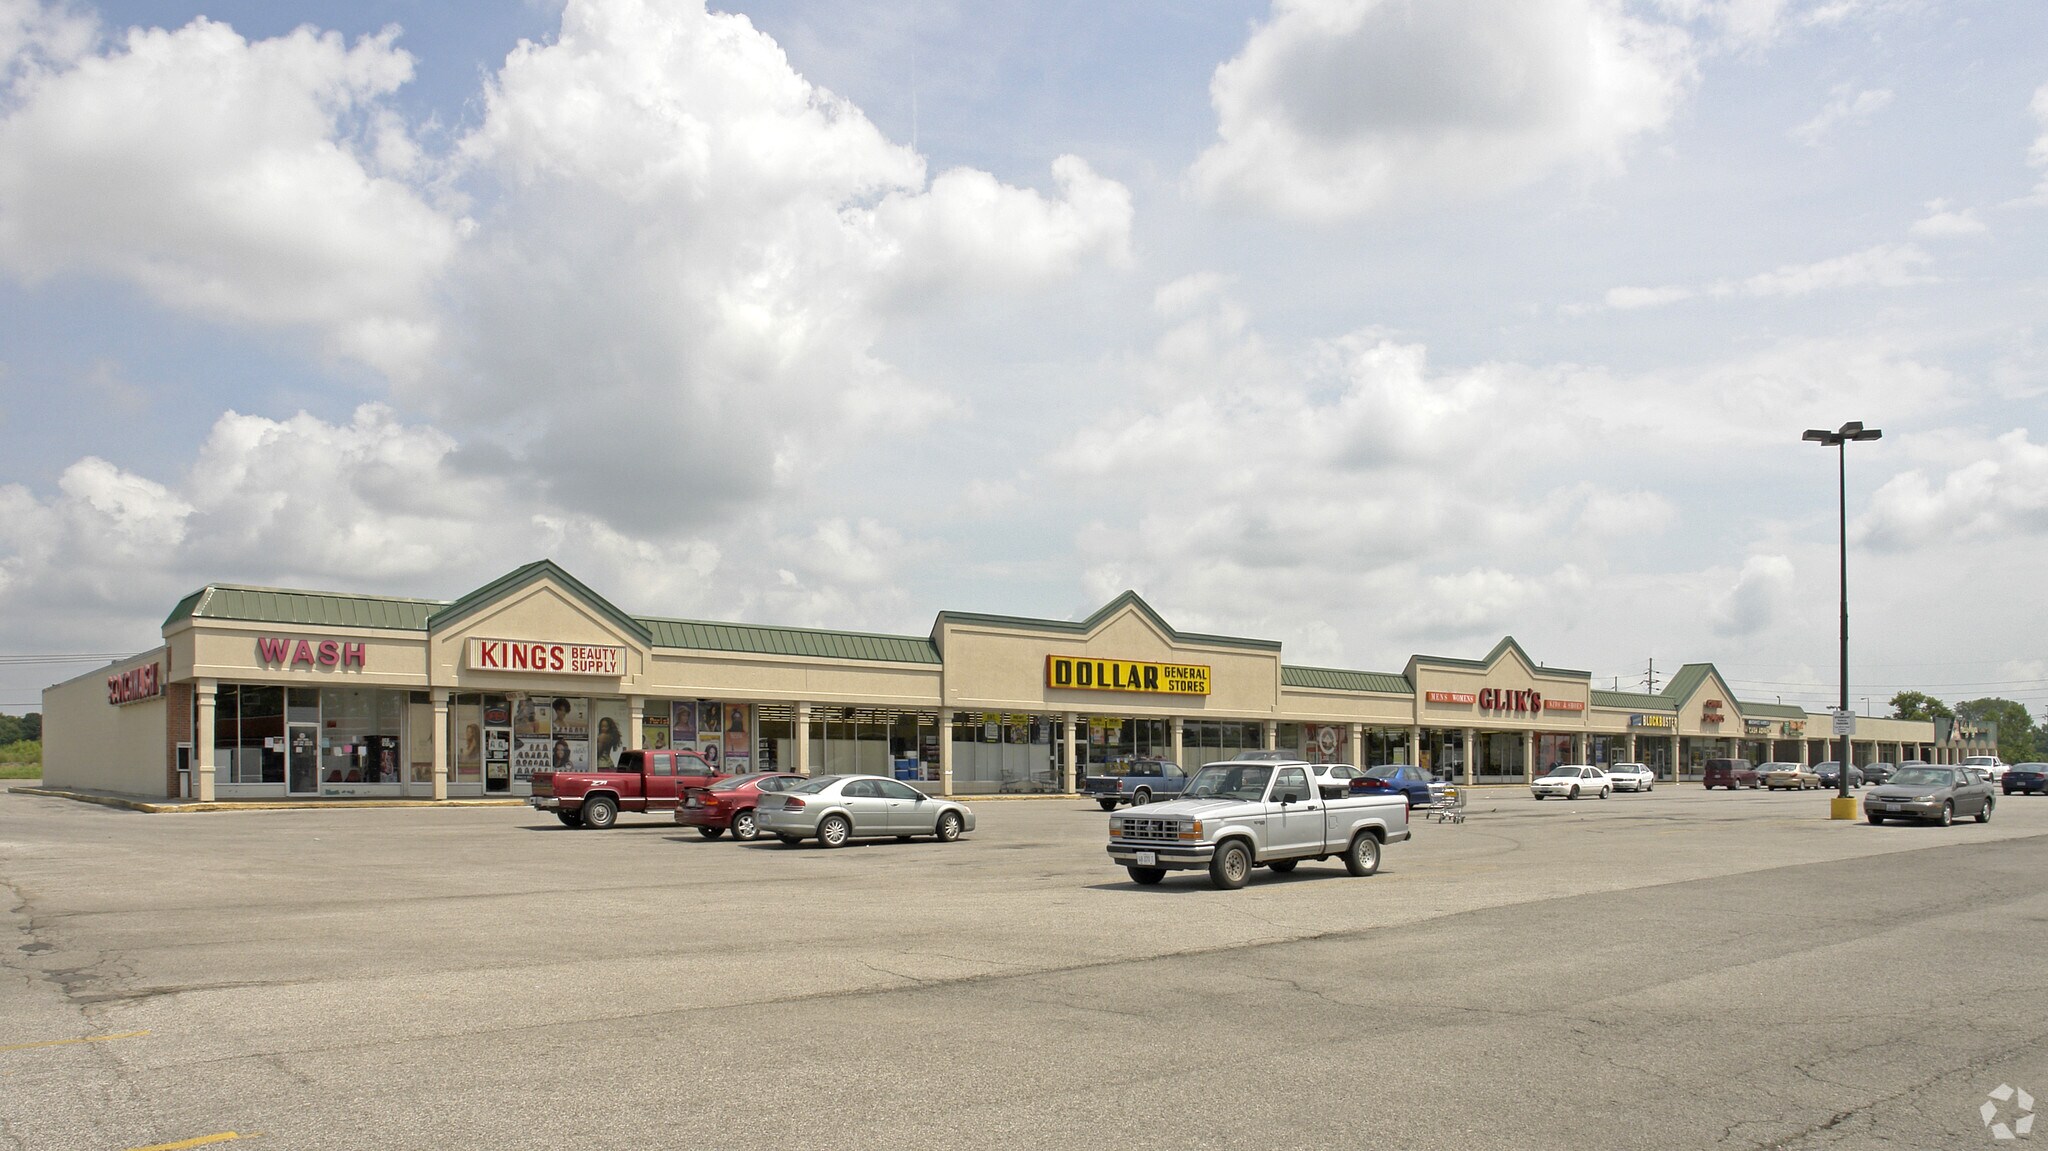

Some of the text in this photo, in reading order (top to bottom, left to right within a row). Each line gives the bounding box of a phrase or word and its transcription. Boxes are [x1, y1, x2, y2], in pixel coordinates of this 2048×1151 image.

[258, 637, 366, 667] WASH
[481, 641, 565, 671] KINGS
[571, 647, 617, 660] BEAUTY
[571, 660, 617, 673] SUPPLY
[1055, 660, 1208, 689] DOLLAR GENERAL
[1168, 680, 1205, 693] STORES
[1478, 687, 1542, 713] GLIK'S
[1642, 714, 1678, 728] BLOCKBUSTER
